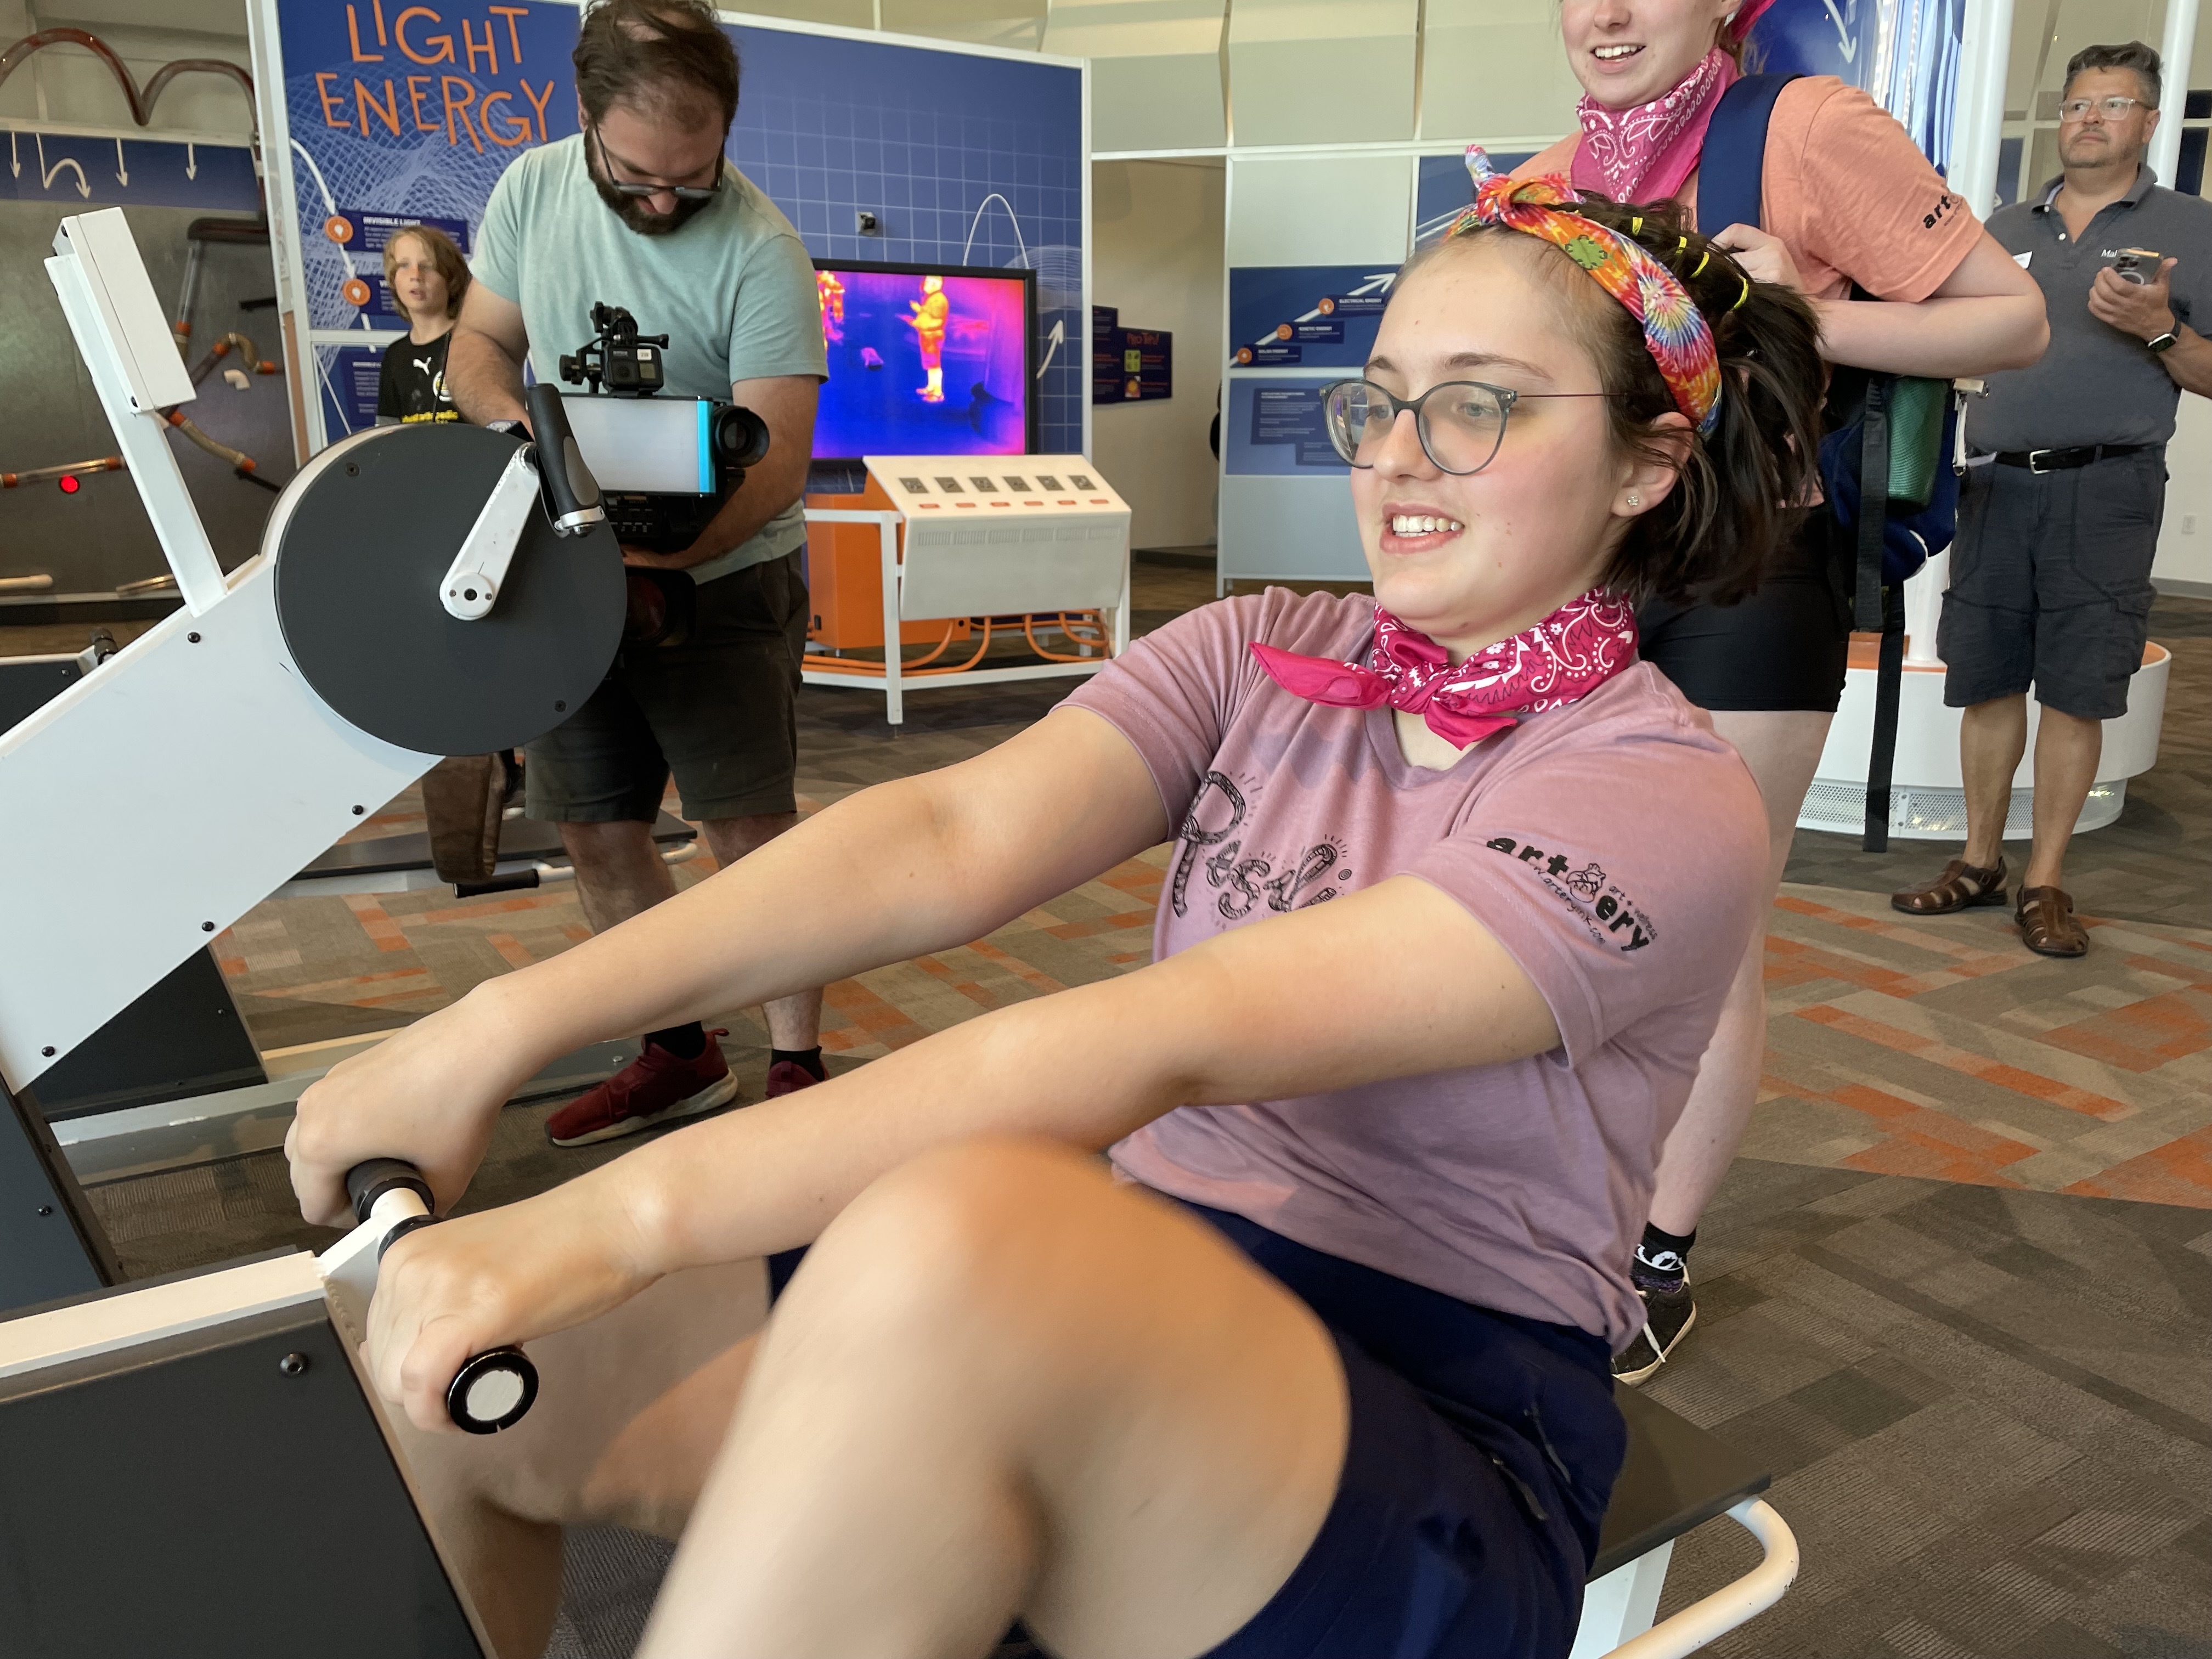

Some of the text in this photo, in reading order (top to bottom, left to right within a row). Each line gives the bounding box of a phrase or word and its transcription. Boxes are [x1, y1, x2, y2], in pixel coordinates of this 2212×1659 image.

[346, 0, 529, 75] LIGHT
[315, 72, 555, 154] ENERGY
[1923, 194, 1951, 229] art
